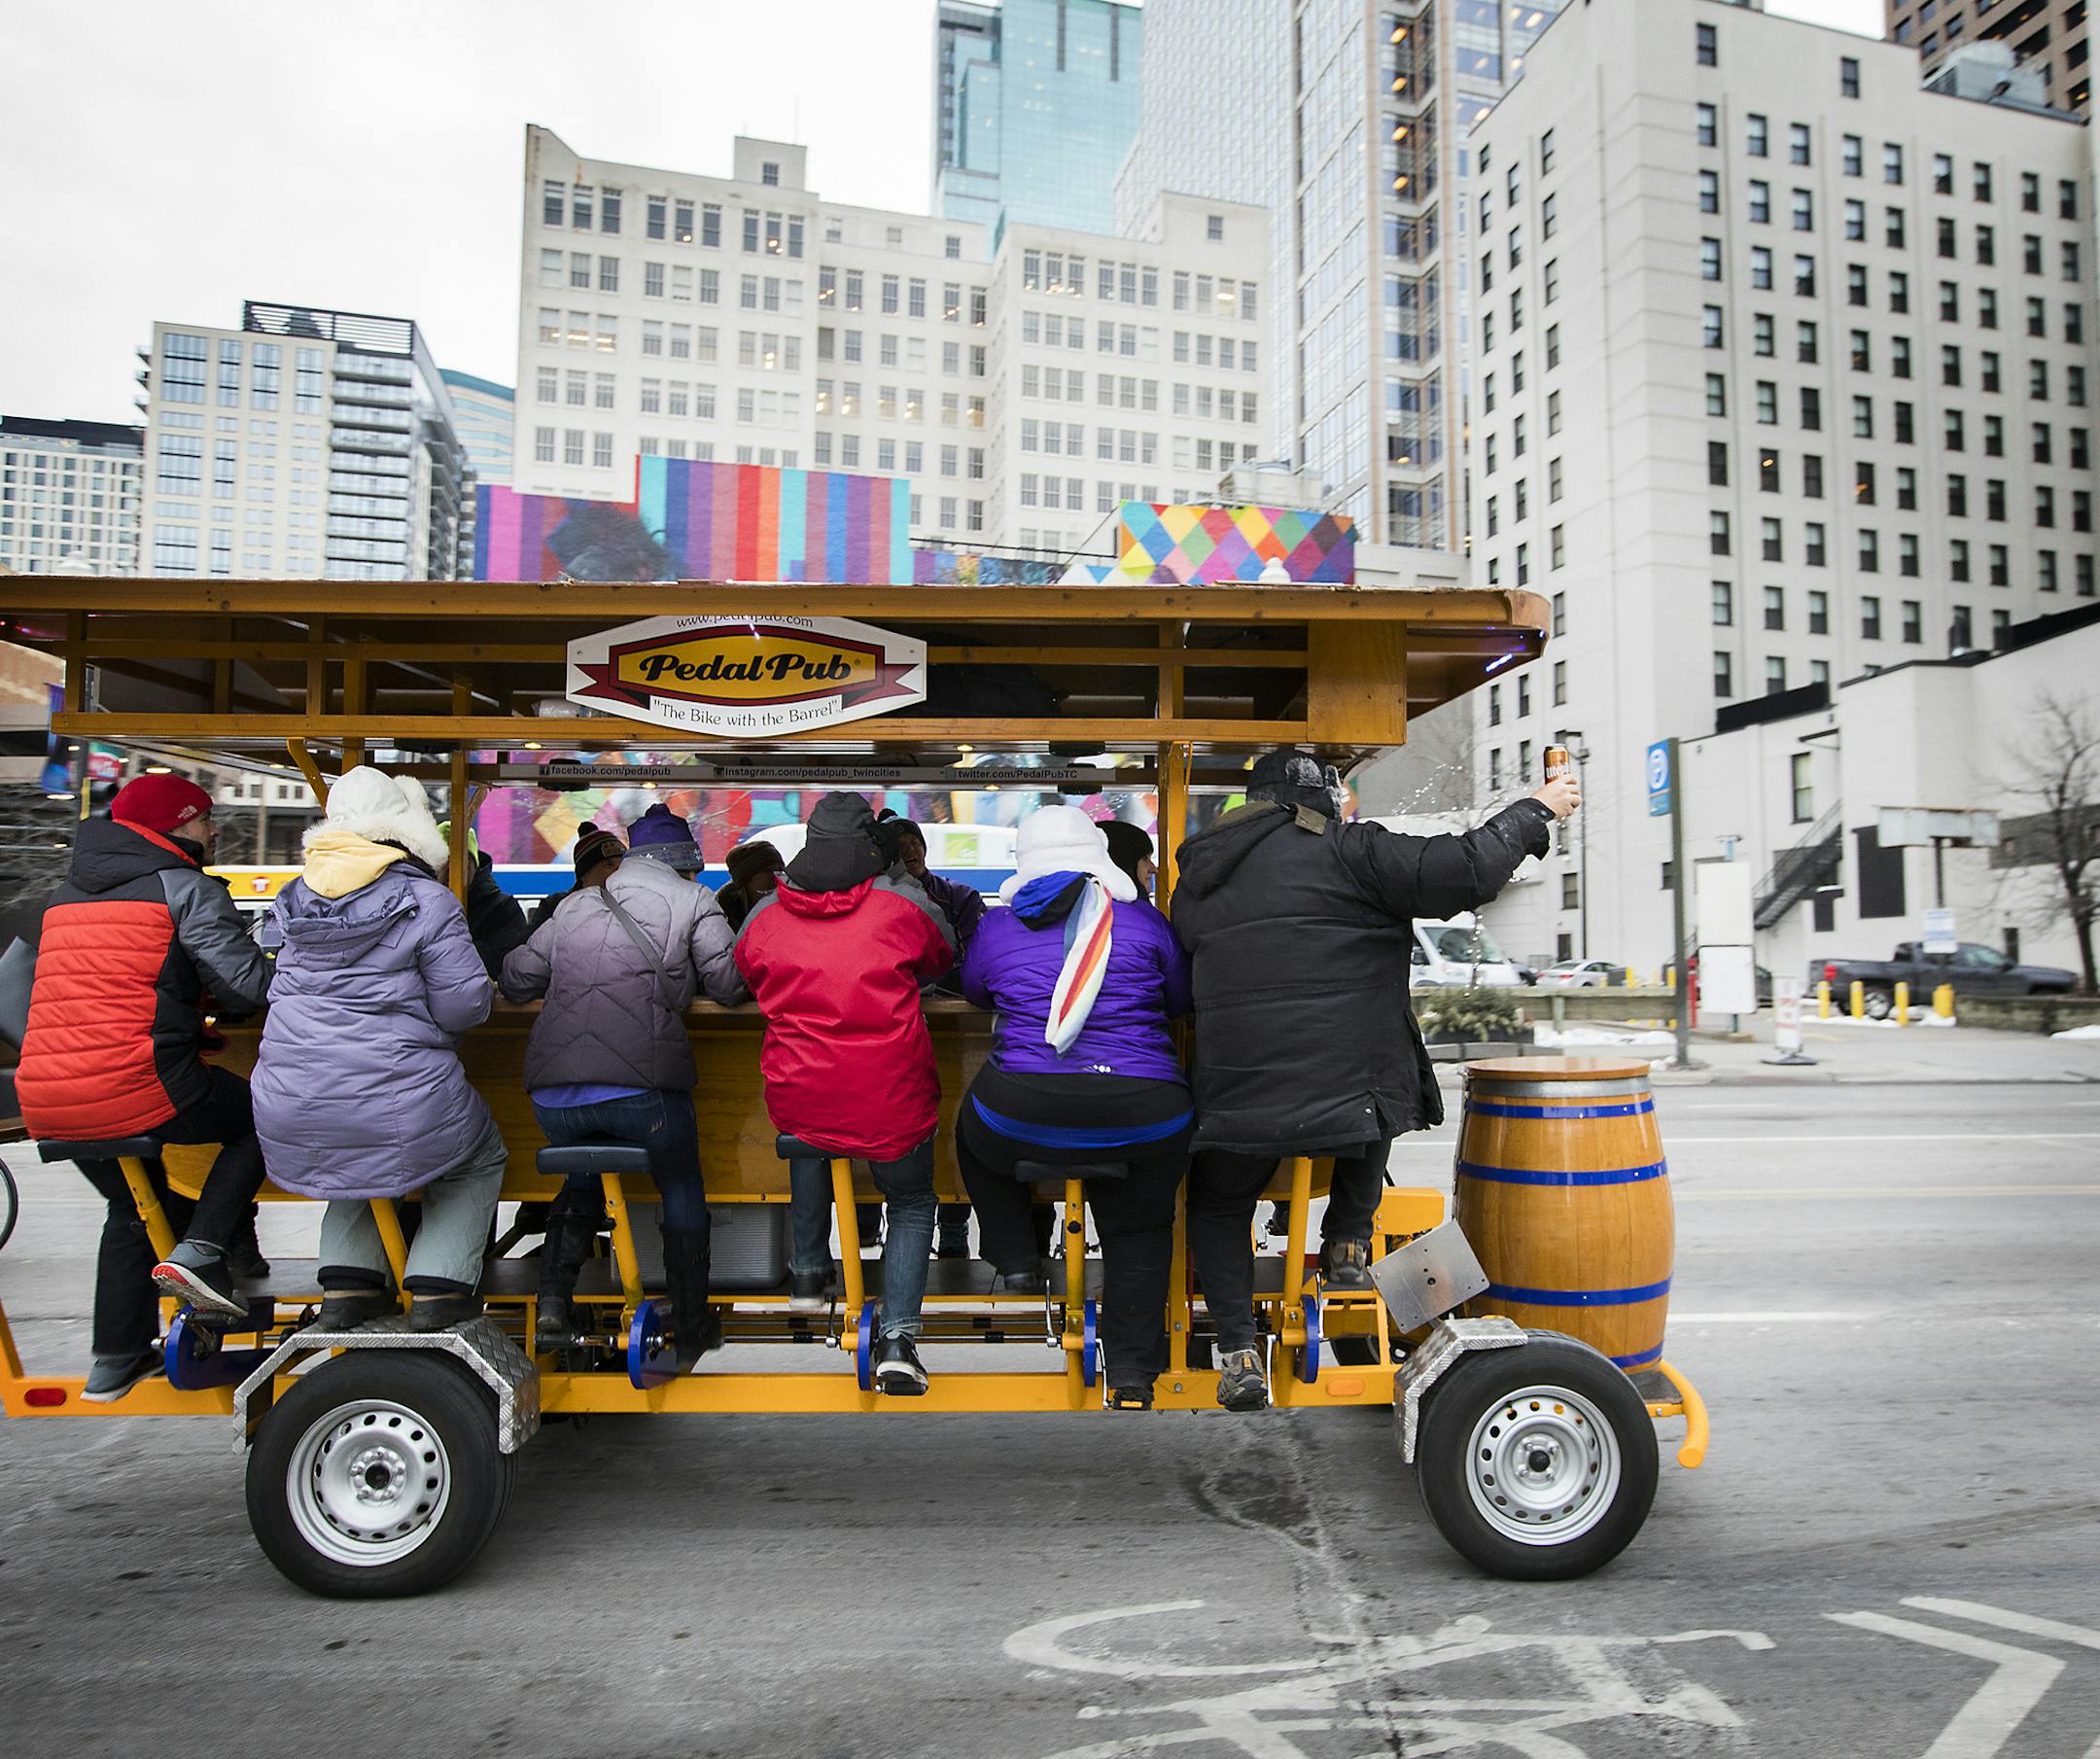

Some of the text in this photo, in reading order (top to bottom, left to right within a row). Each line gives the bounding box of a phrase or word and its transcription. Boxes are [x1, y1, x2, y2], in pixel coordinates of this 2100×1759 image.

[690, 708, 721, 725] Bike
[726, 713, 756, 727] with
[761, 713, 784, 726] the
[551, 765, 671, 777] facebook.com/pedalpub
[725, 766, 901, 779] instagram.com/pedalpub_twincities
[959, 769, 1077, 780] twitter.com/PedalPubTC
